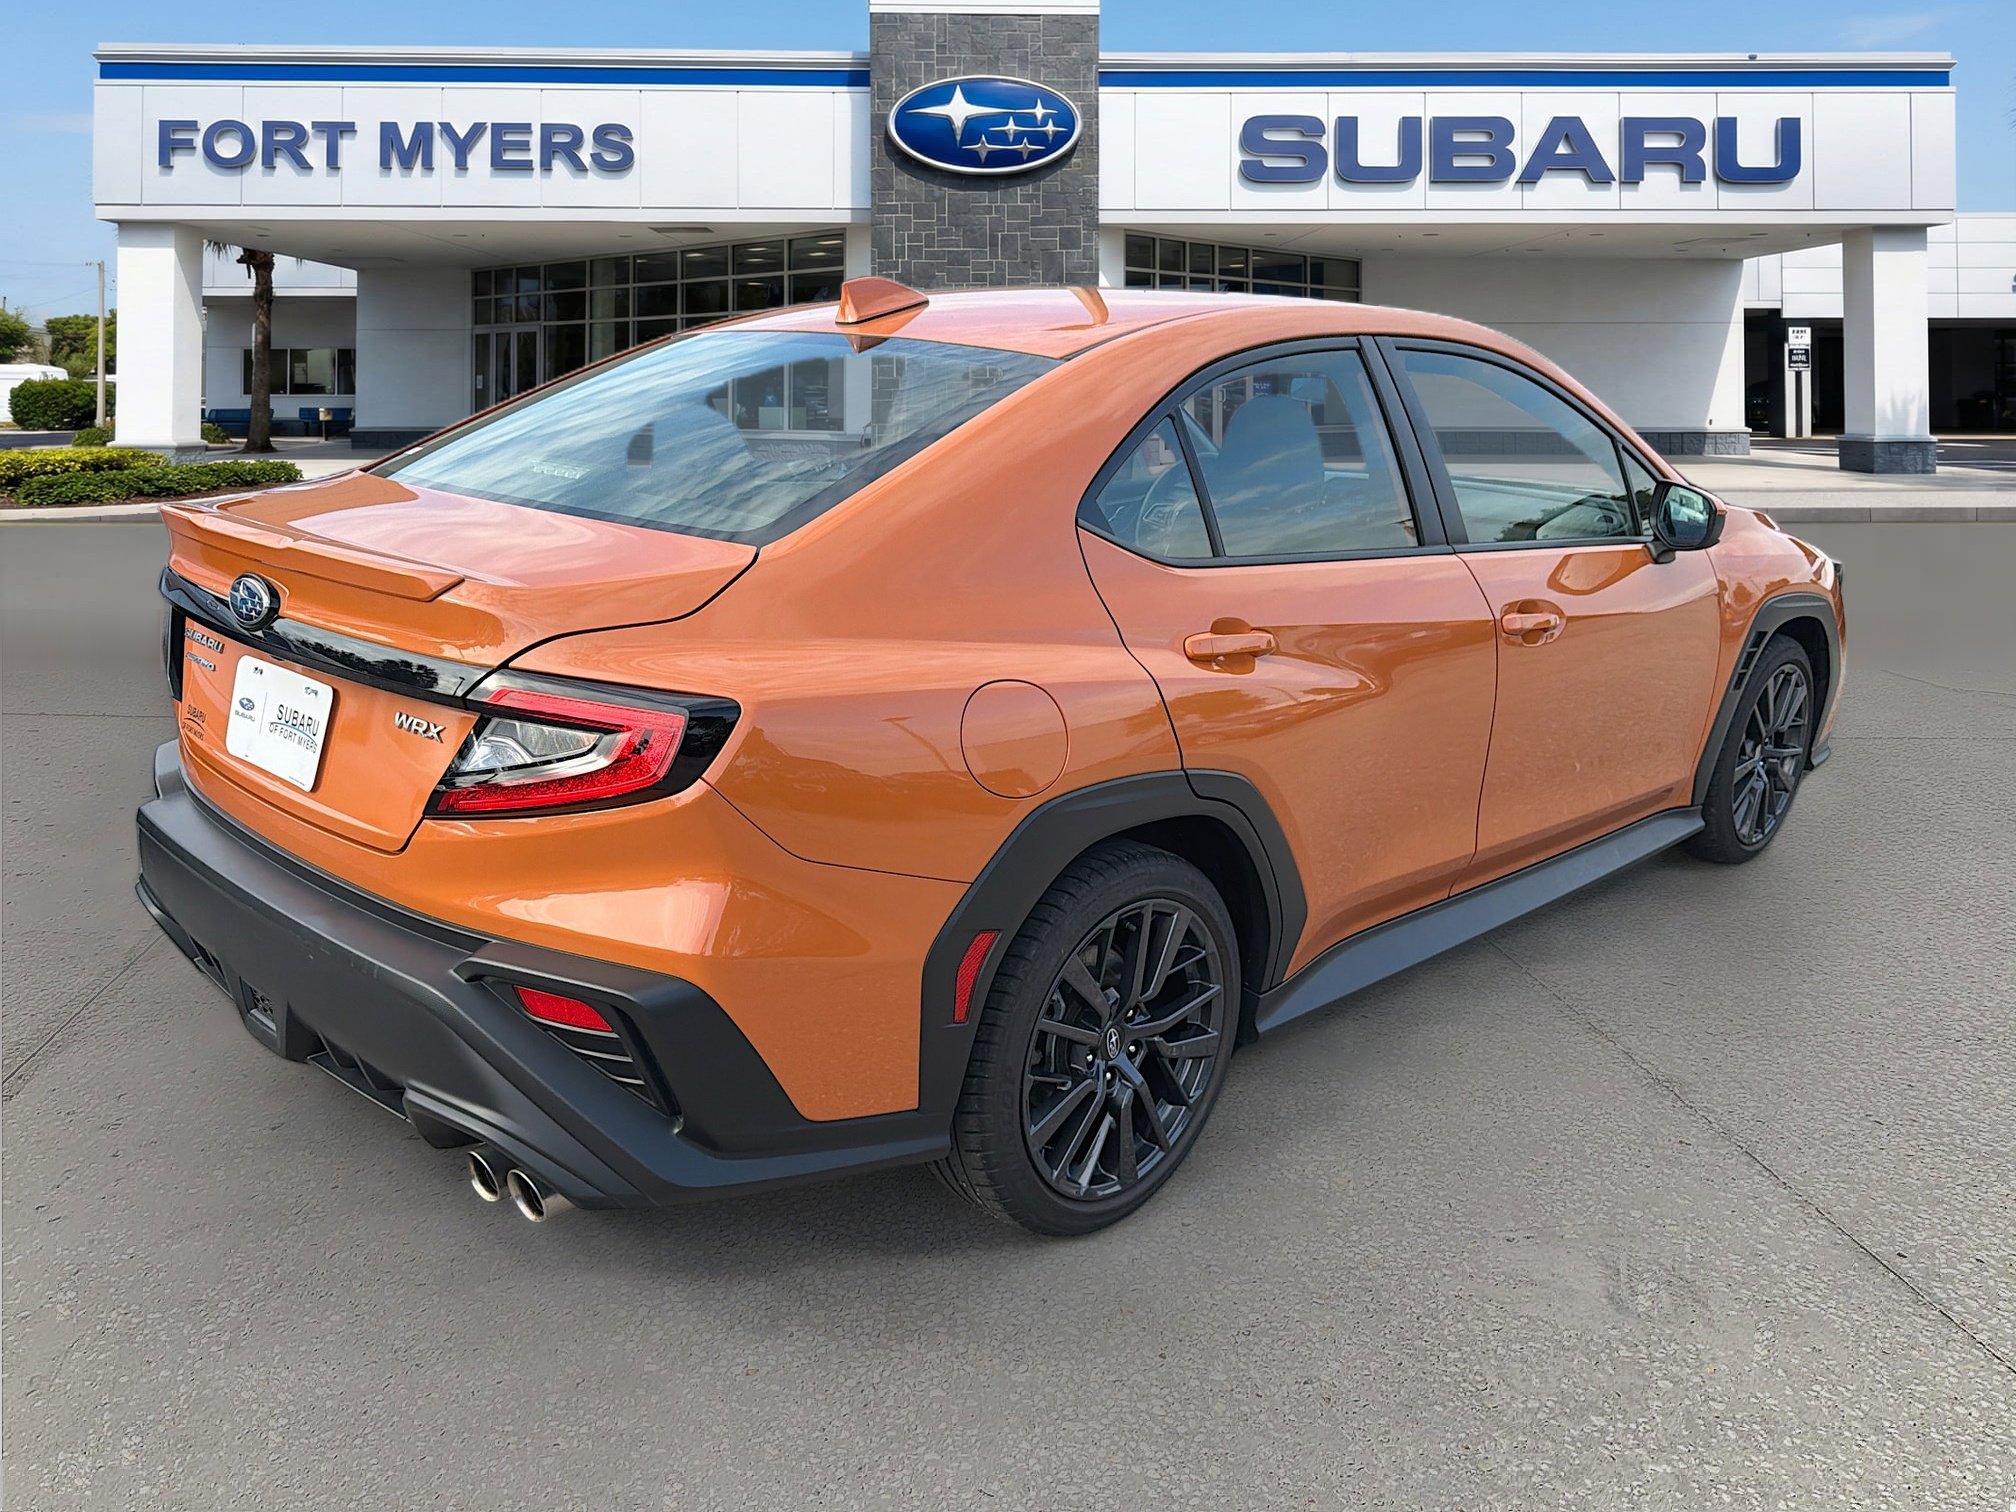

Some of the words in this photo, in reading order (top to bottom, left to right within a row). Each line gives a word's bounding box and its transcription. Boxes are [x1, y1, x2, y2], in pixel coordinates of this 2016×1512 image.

[158, 119, 356, 169] FORT
[379, 121, 635, 171] MYERS
[1239, 115, 1802, 185] SUBARU
[184, 628, 225, 654] SUBARU
[277, 704, 320, 737] SUBARU
[394, 711, 447, 744] WRX
[269, 723, 279, 734] OF
[279, 726, 298, 743] FORT
[297, 734, 318, 754] MYERS
